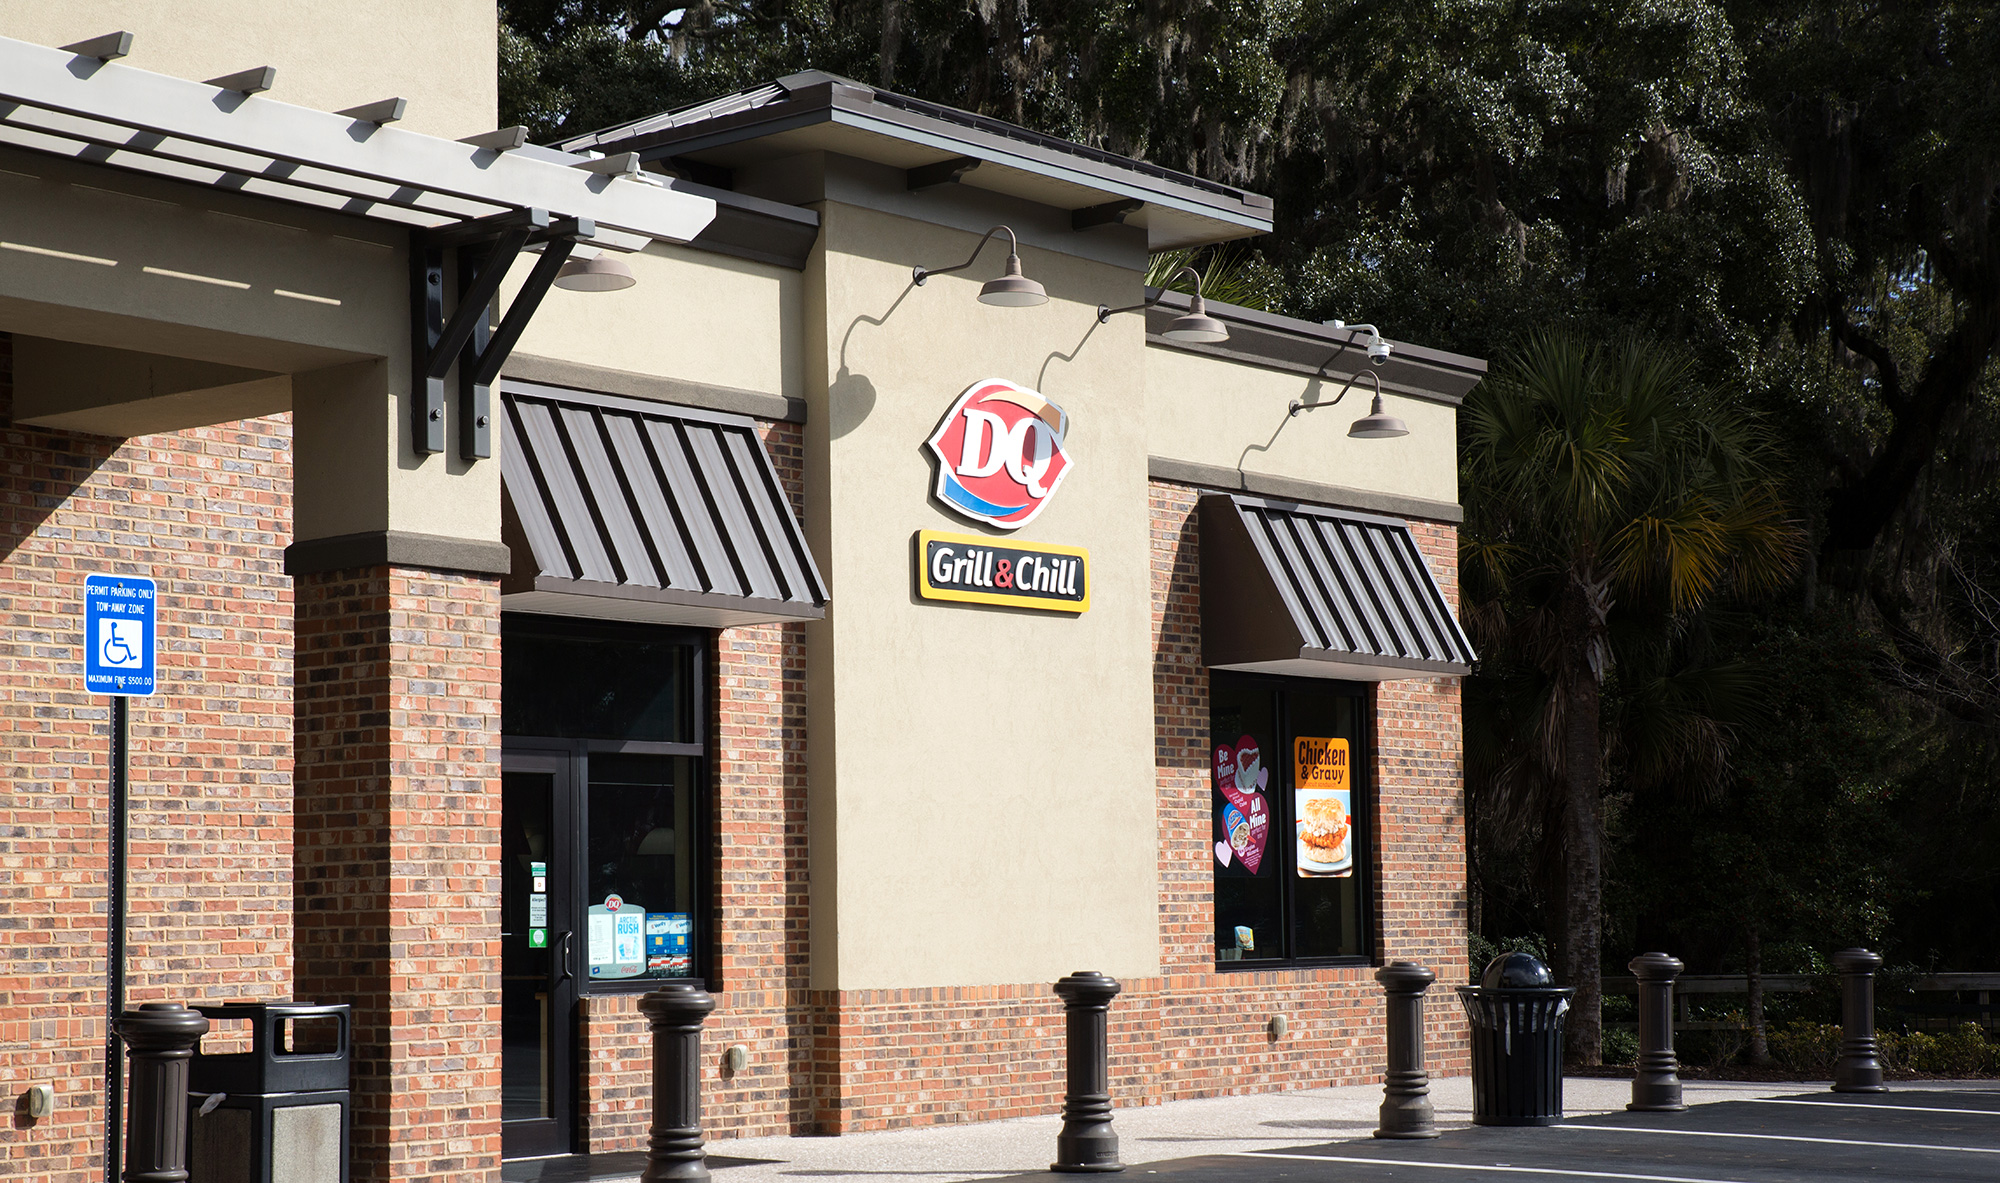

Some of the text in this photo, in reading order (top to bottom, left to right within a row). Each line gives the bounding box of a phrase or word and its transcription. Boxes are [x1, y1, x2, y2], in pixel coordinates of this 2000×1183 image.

[956, 408, 1052, 499] DQ
[86, 585, 154, 599] PERMIT PARKING ONLY
[96, 601, 145, 615] TOW-AWAY ZONE
[88, 674, 153, 686] MAXIMUM FINE $500.00
[1218, 749, 1229, 763] Be
[1298, 741, 1346, 766] Chicken
[1217, 763, 1235, 779] Mine
[1301, 765, 1344, 784] & Gravy
[1250, 797, 1261, 814] All
[1249, 813, 1267, 829] Mine
[608, 900, 620, 909] DQ
[617, 923, 639, 934] RUSH
